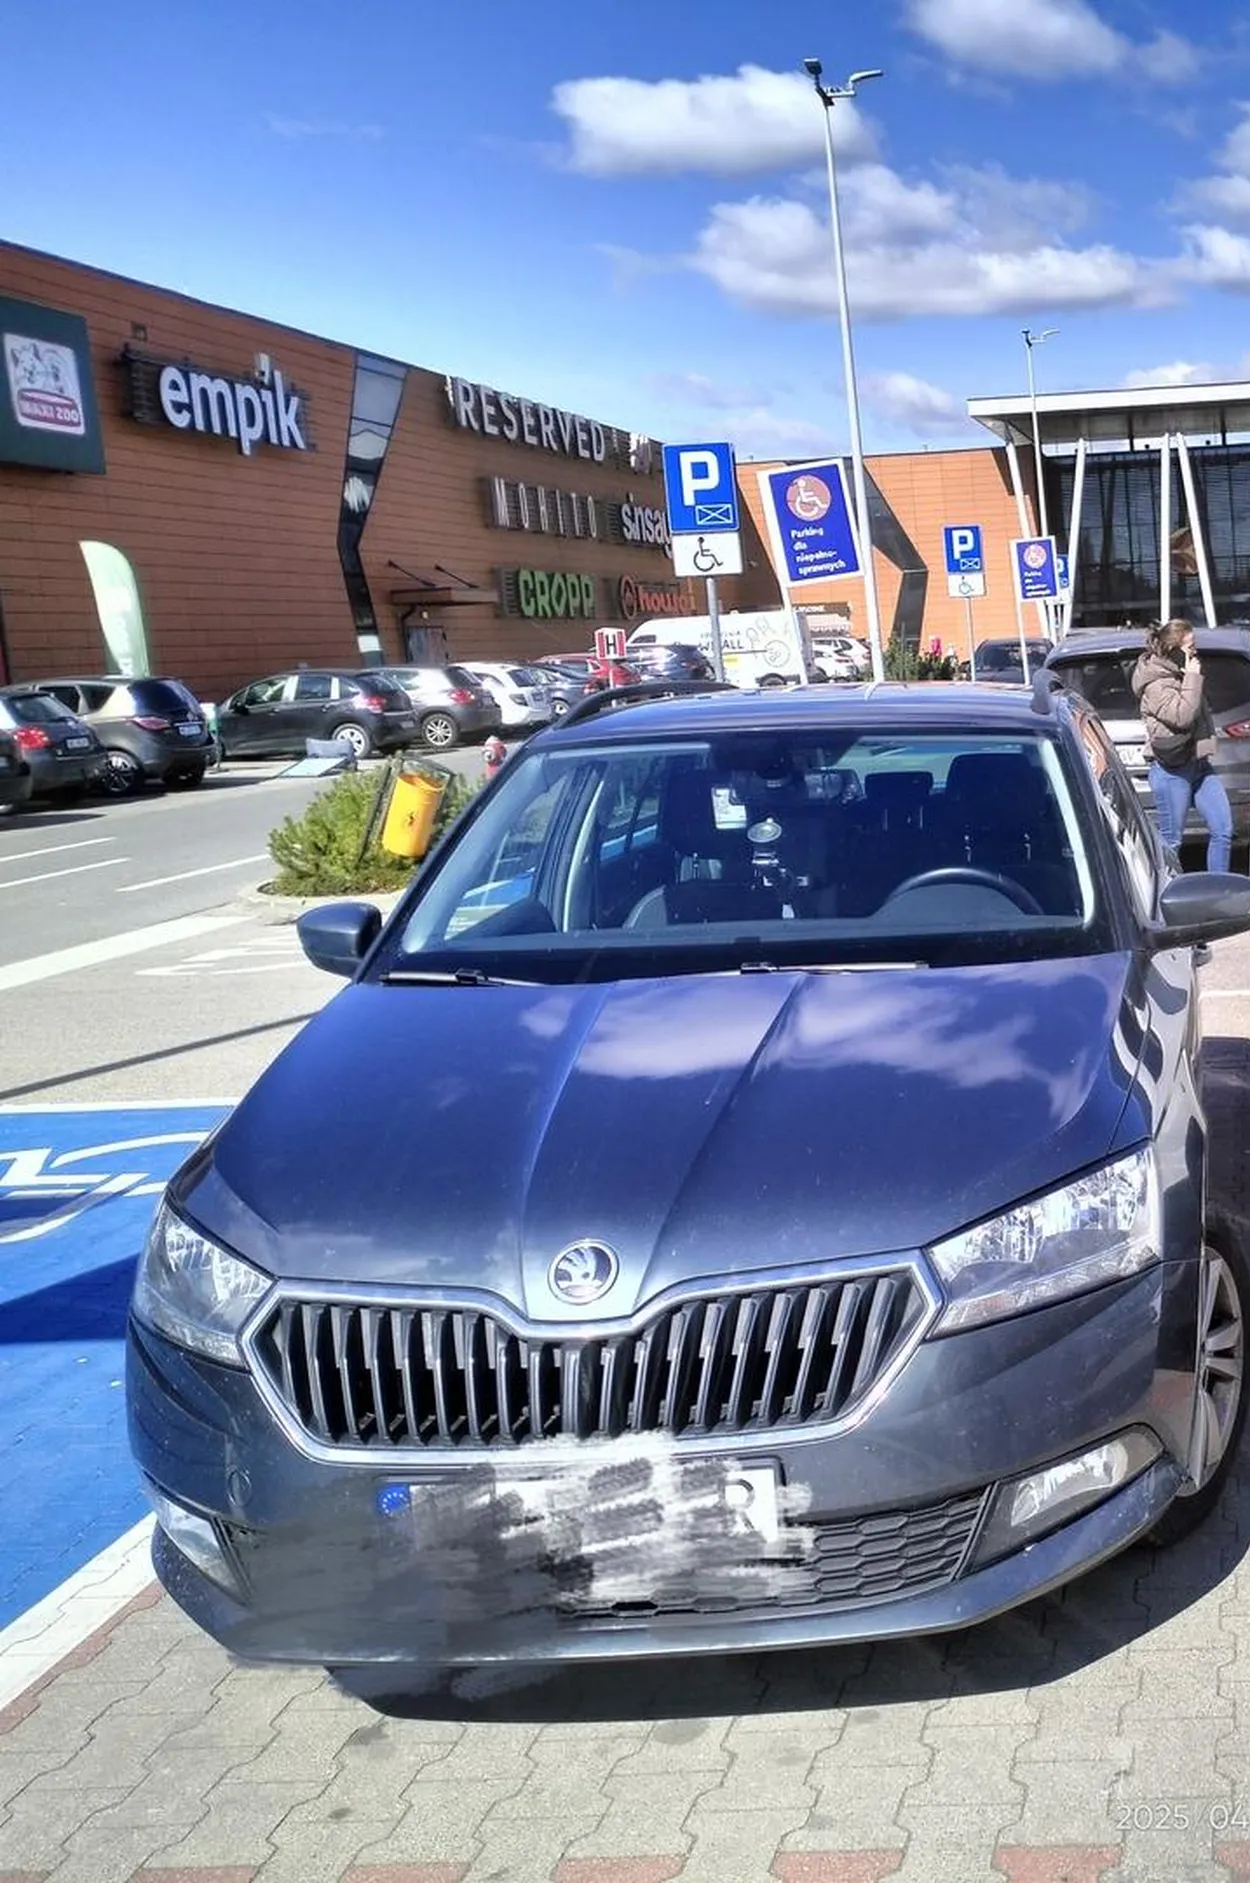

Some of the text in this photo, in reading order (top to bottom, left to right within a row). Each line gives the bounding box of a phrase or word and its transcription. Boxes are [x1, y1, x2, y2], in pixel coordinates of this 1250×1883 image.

[159, 351, 308, 457] empik
[452, 375, 606, 462] RESERVED
[679, 450, 720, 507] P
[952, 528, 975, 560] P
[518, 568, 595, 618] CROPP
[605, 633, 618, 655] H
